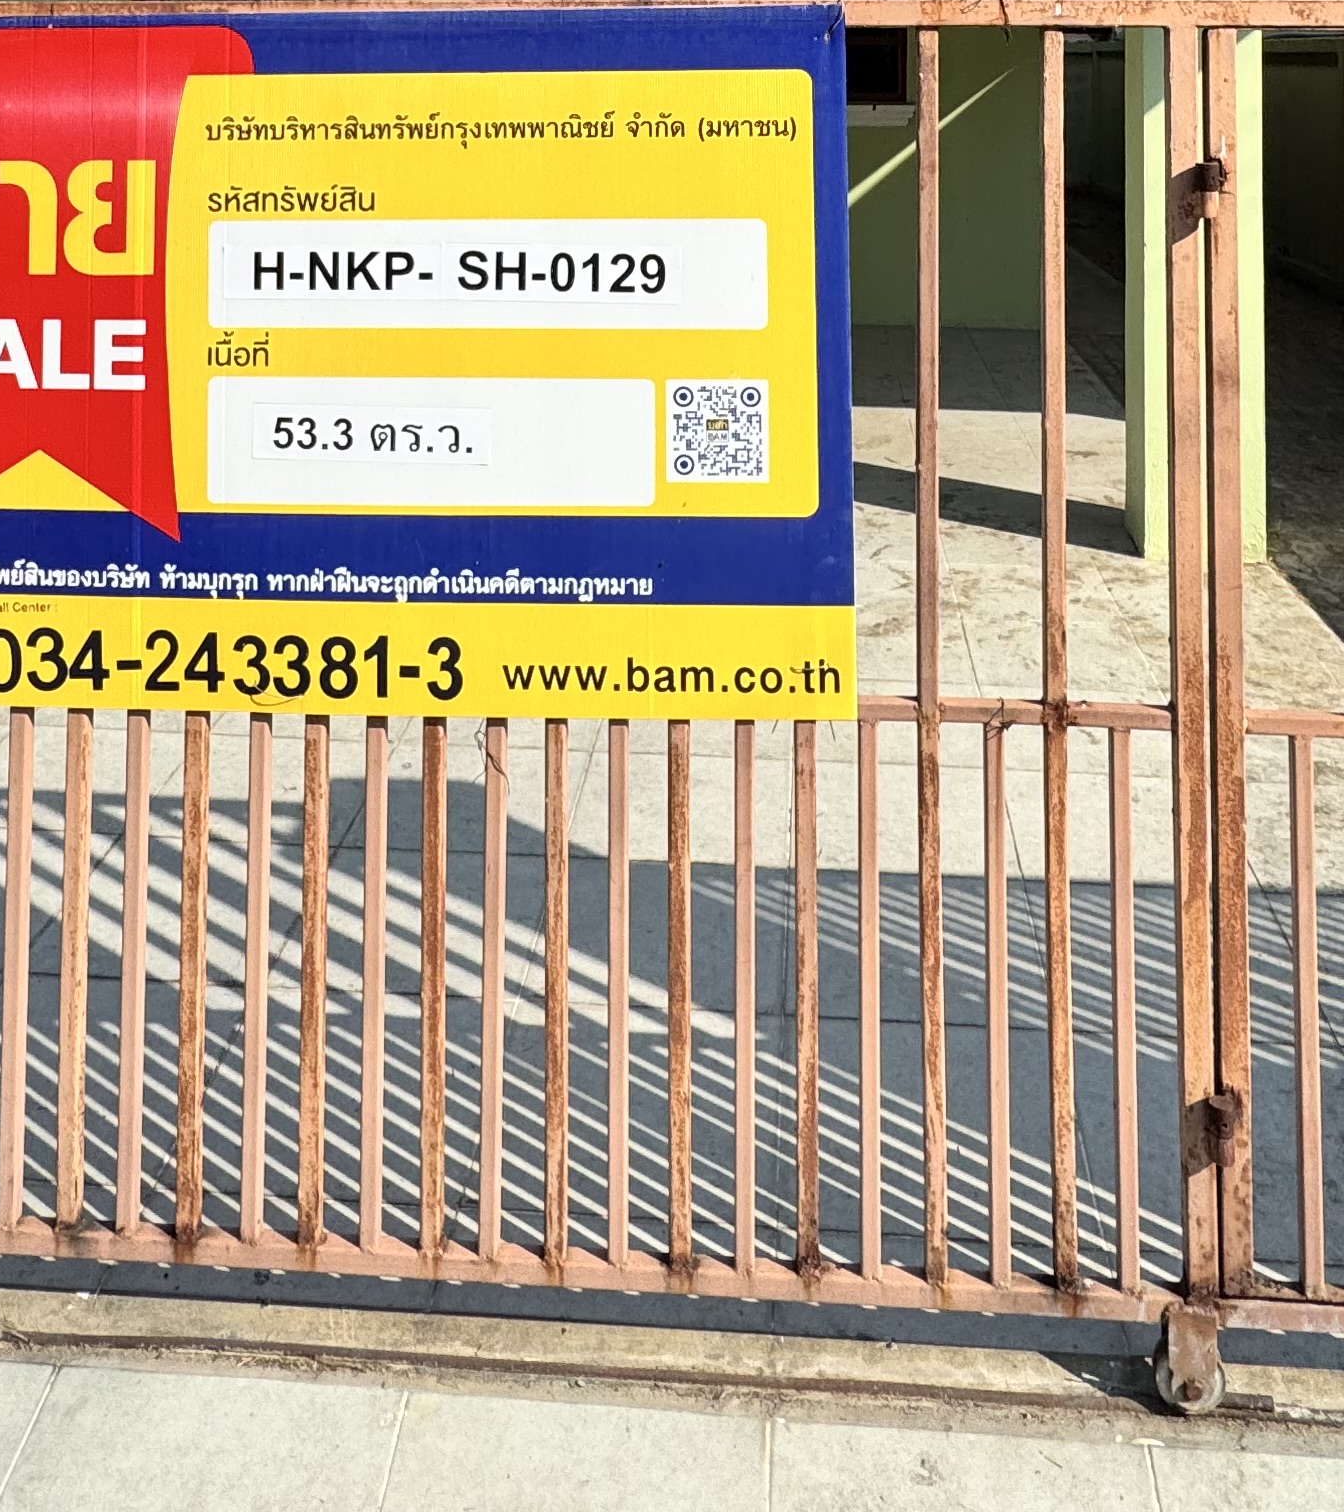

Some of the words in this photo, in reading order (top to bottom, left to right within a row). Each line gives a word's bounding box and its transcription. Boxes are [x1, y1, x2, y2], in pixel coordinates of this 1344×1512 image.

[205, 111, 615, 150] บริษัทบริหารสินทรัพย์กรุงเทพพาณิชย์
[625, 111, 686, 138] จำกัด
[698, 116, 797, 143] (มหาชน)
[207, 184, 375, 213] รหัสทรัพย์สิน
[253, 251, 433, 291] H-NKP-
[457, 251, 666, 294] SH-0129
[207, 331, 269, 368] เนื้อที่
[273, 417, 353, 451] 53.3
[370, 423, 473, 454] ตร.ว.
[159, 563, 259, 599] ห้ามบุกรุก
[266, 566, 654, 602] หากฝ่าฝืนจะถูกดำเนินคดีตามกฎหมาย
[502, 657, 841, 694] www.bam.co.th
